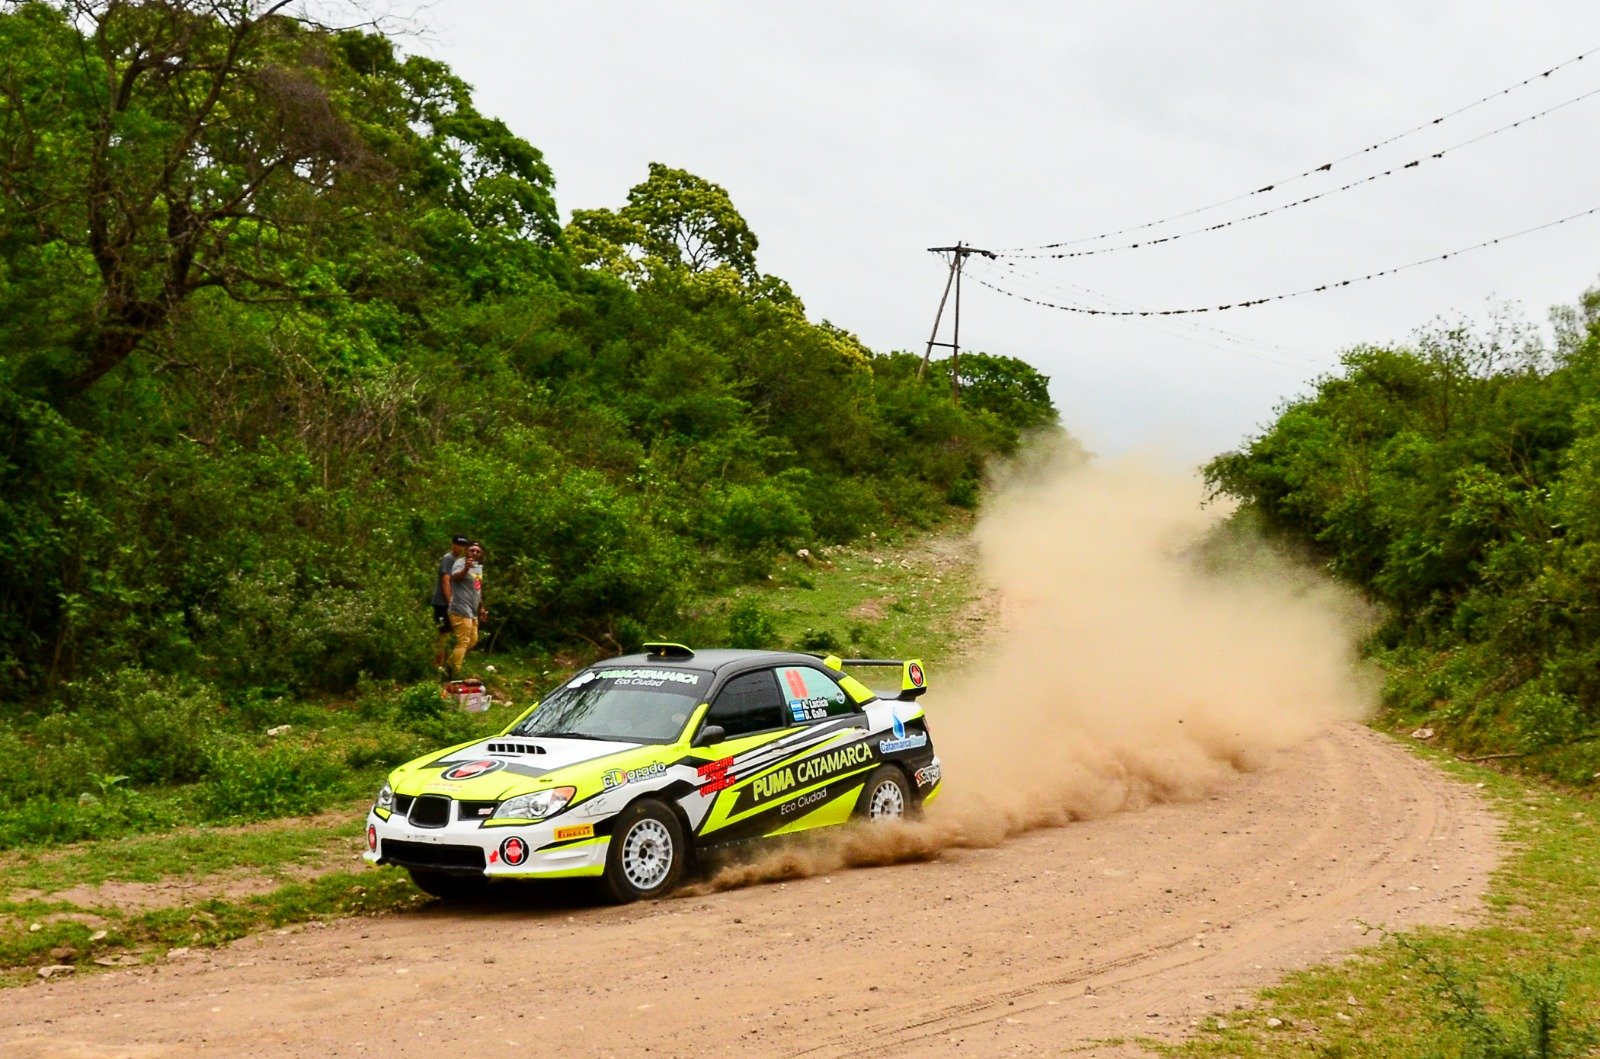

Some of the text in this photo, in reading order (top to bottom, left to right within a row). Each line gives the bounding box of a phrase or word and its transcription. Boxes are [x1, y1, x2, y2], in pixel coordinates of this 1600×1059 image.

[631, 679, 664, 687] Ciudad
[753, 768, 795, 801] PUMA
[797, 742, 873, 782] CATAMARCA
[700, 775, 736, 798] VARELA
[781, 787, 827, 815] Eco Ciudad
